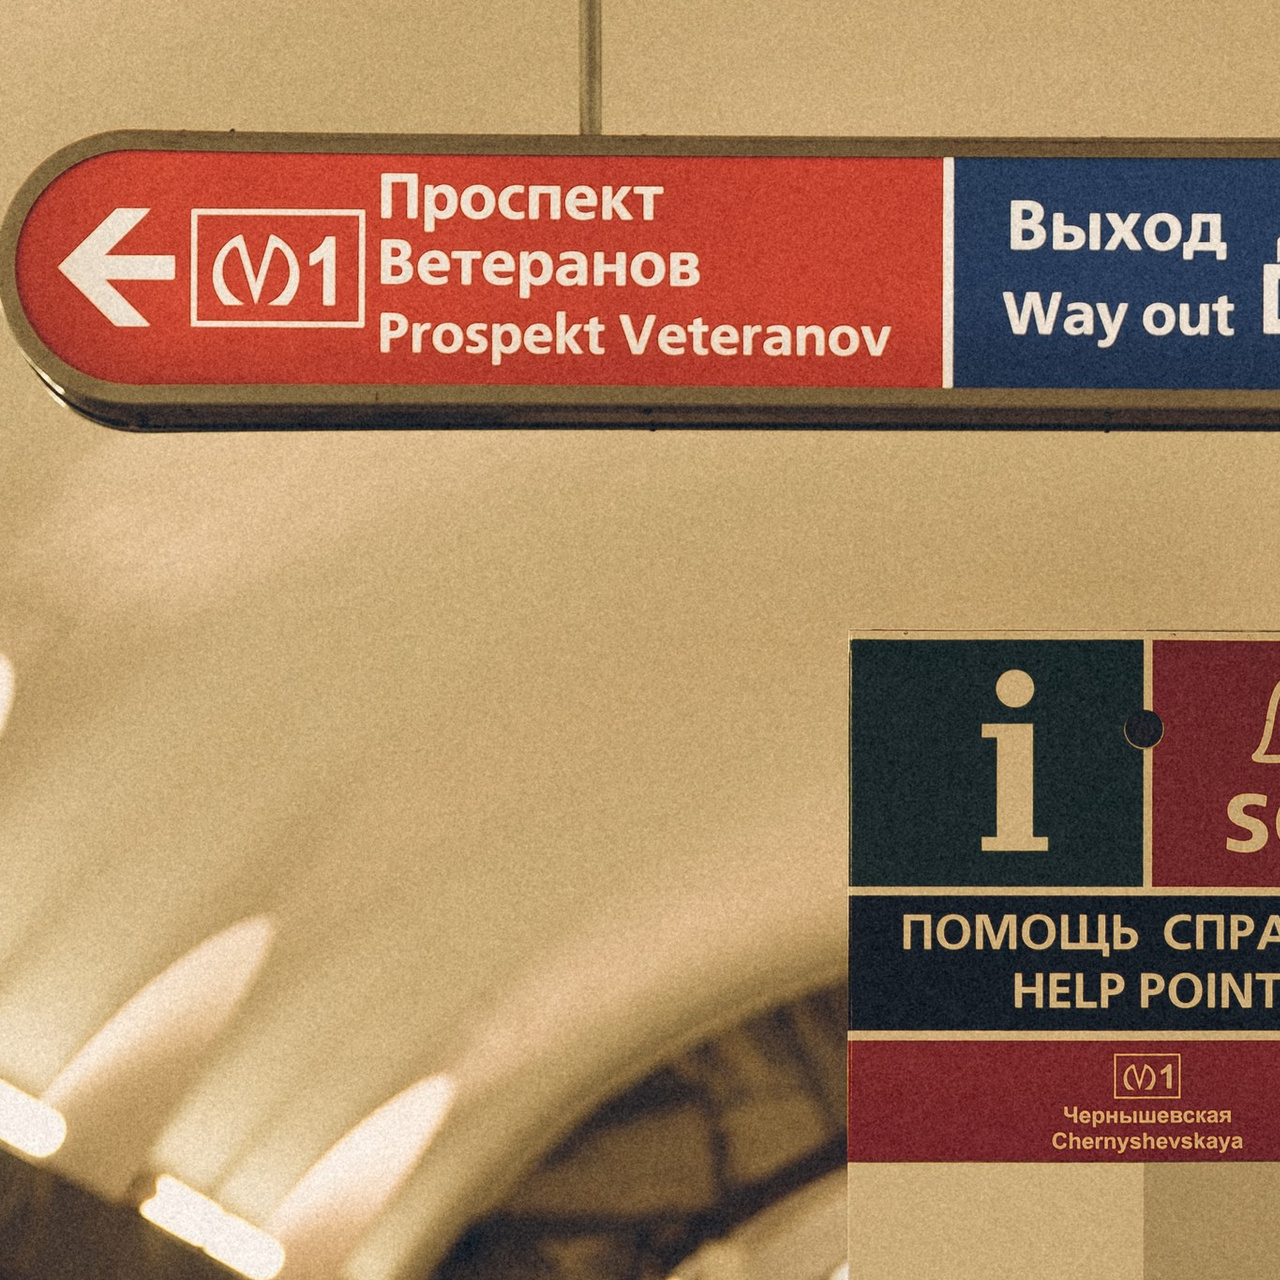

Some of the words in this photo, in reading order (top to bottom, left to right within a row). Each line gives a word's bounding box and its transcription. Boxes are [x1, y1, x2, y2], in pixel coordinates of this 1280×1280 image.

[381, 173, 664, 232] Проспект
[1011, 200, 1227, 260] Выход
[381, 238, 700, 290] Ветеранов
[380, 311, 605, 360] Prospekt
[620, 315, 891, 356] Veteranov
[1003, 292, 1128, 347] Way
[1143, 296, 1234, 336] out
[903, 914, 1138, 957] ПОМОЩЬ
[1015, 973, 1125, 1008] HELP
[1064, 1106, 1231, 1126] Чернышевская
[1052, 1132, 1243, 1154] Chernyshevskaya
